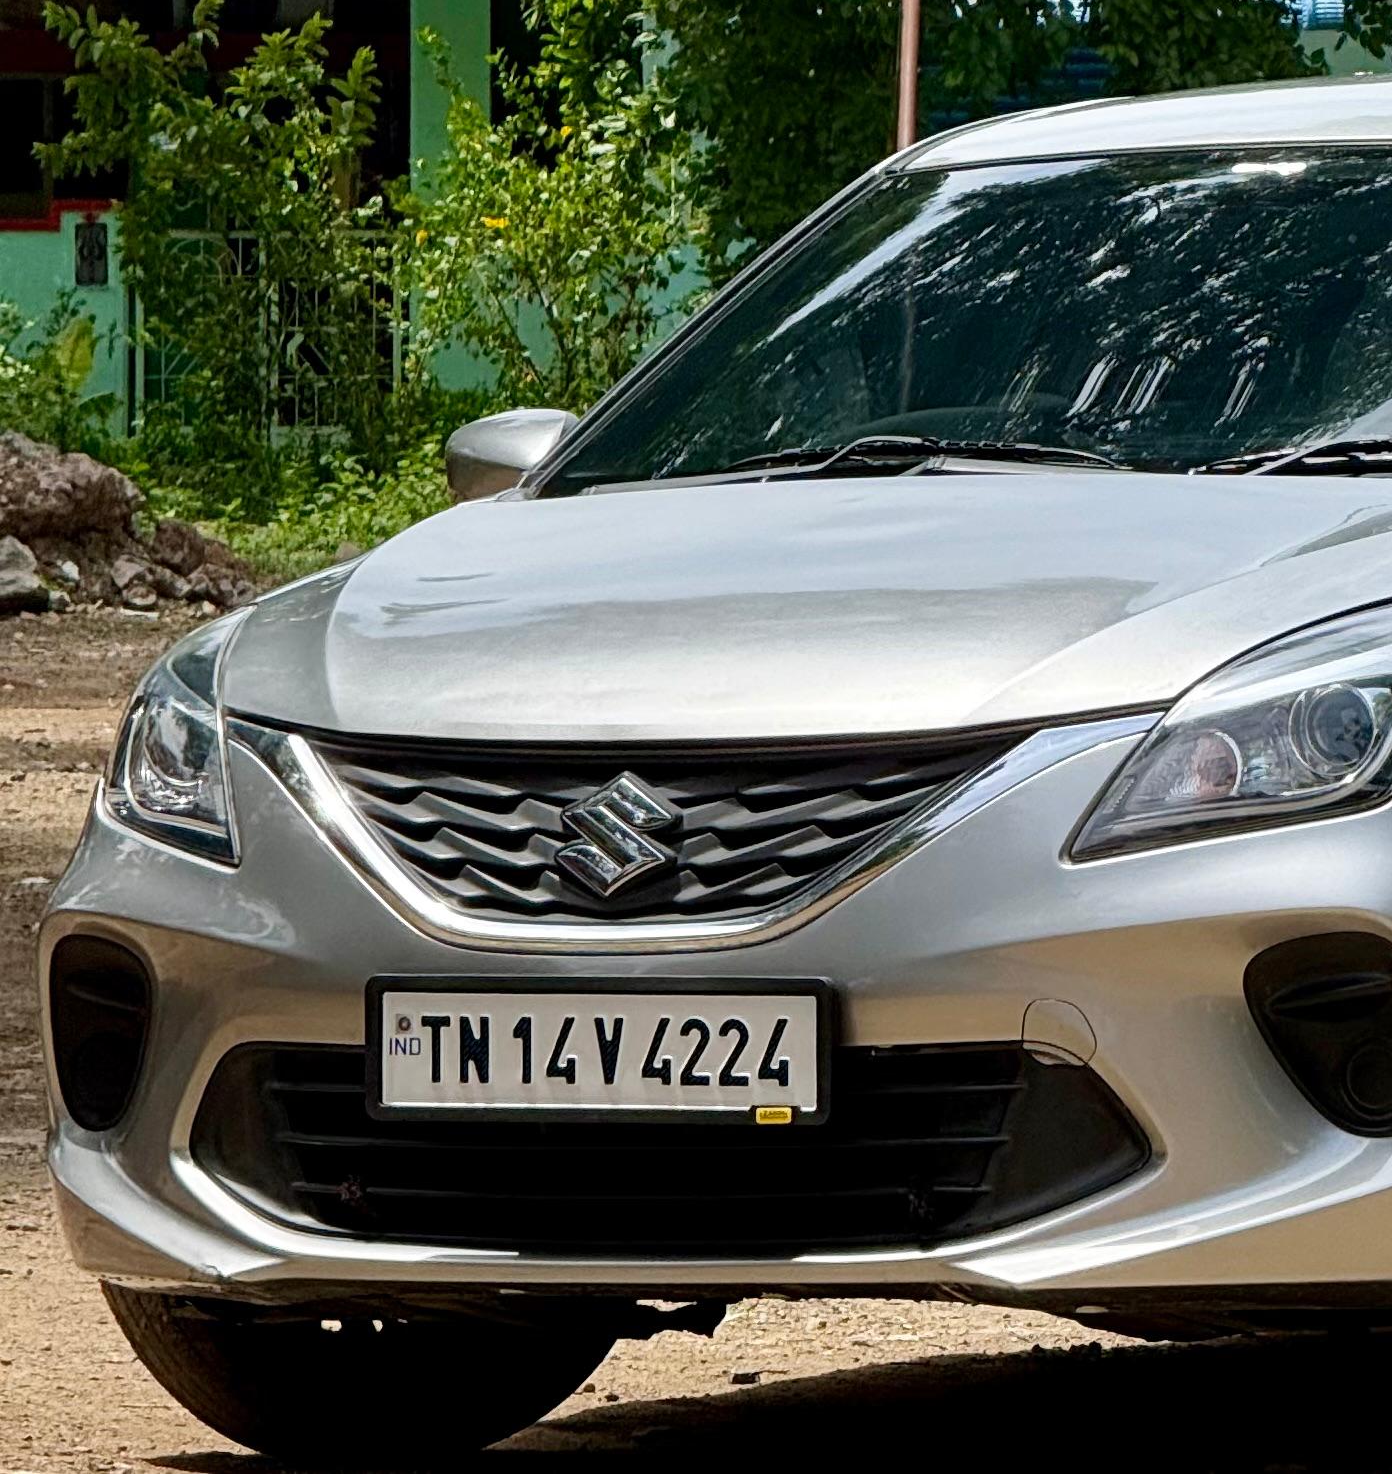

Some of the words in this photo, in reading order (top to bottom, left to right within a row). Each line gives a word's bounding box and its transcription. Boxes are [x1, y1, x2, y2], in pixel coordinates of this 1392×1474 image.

[389, 1037, 421, 1056] IND
[421, 1015, 490, 1084] TN
[512, 1016, 576, 1085] 14
[593, 1017, 624, 1086] V
[641, 1017, 789, 1087] 4224
